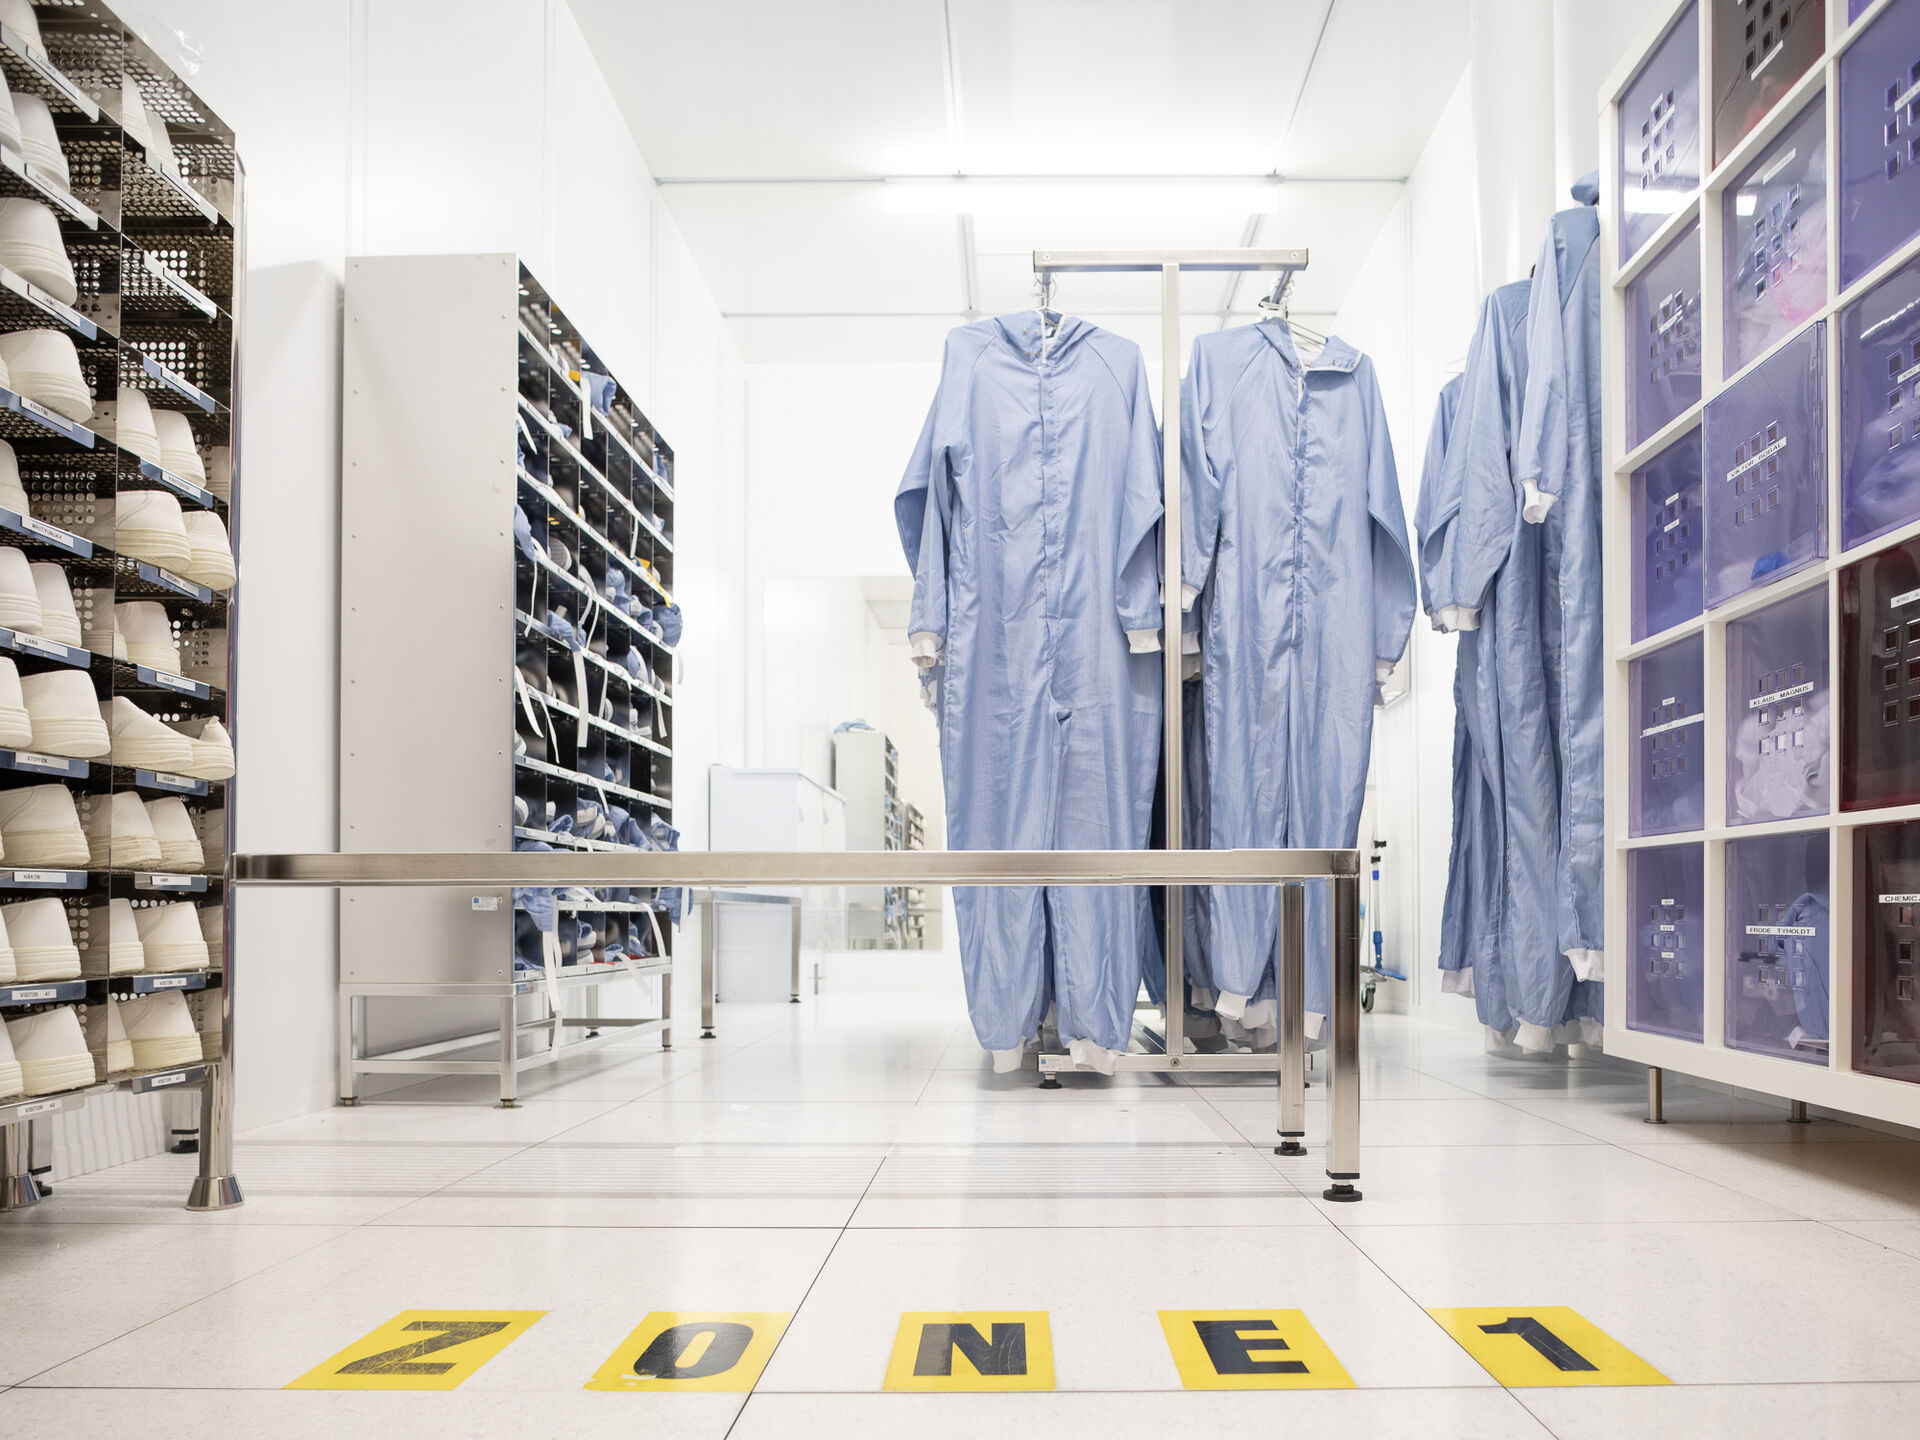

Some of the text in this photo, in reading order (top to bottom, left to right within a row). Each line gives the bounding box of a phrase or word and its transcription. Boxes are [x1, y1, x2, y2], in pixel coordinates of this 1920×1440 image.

[1731, 460, 1755, 477] VIKTOR
[1753, 685, 1809, 706] KLAUS MAGNUS
[333, 1316, 1600, 1380] ZONE 1
